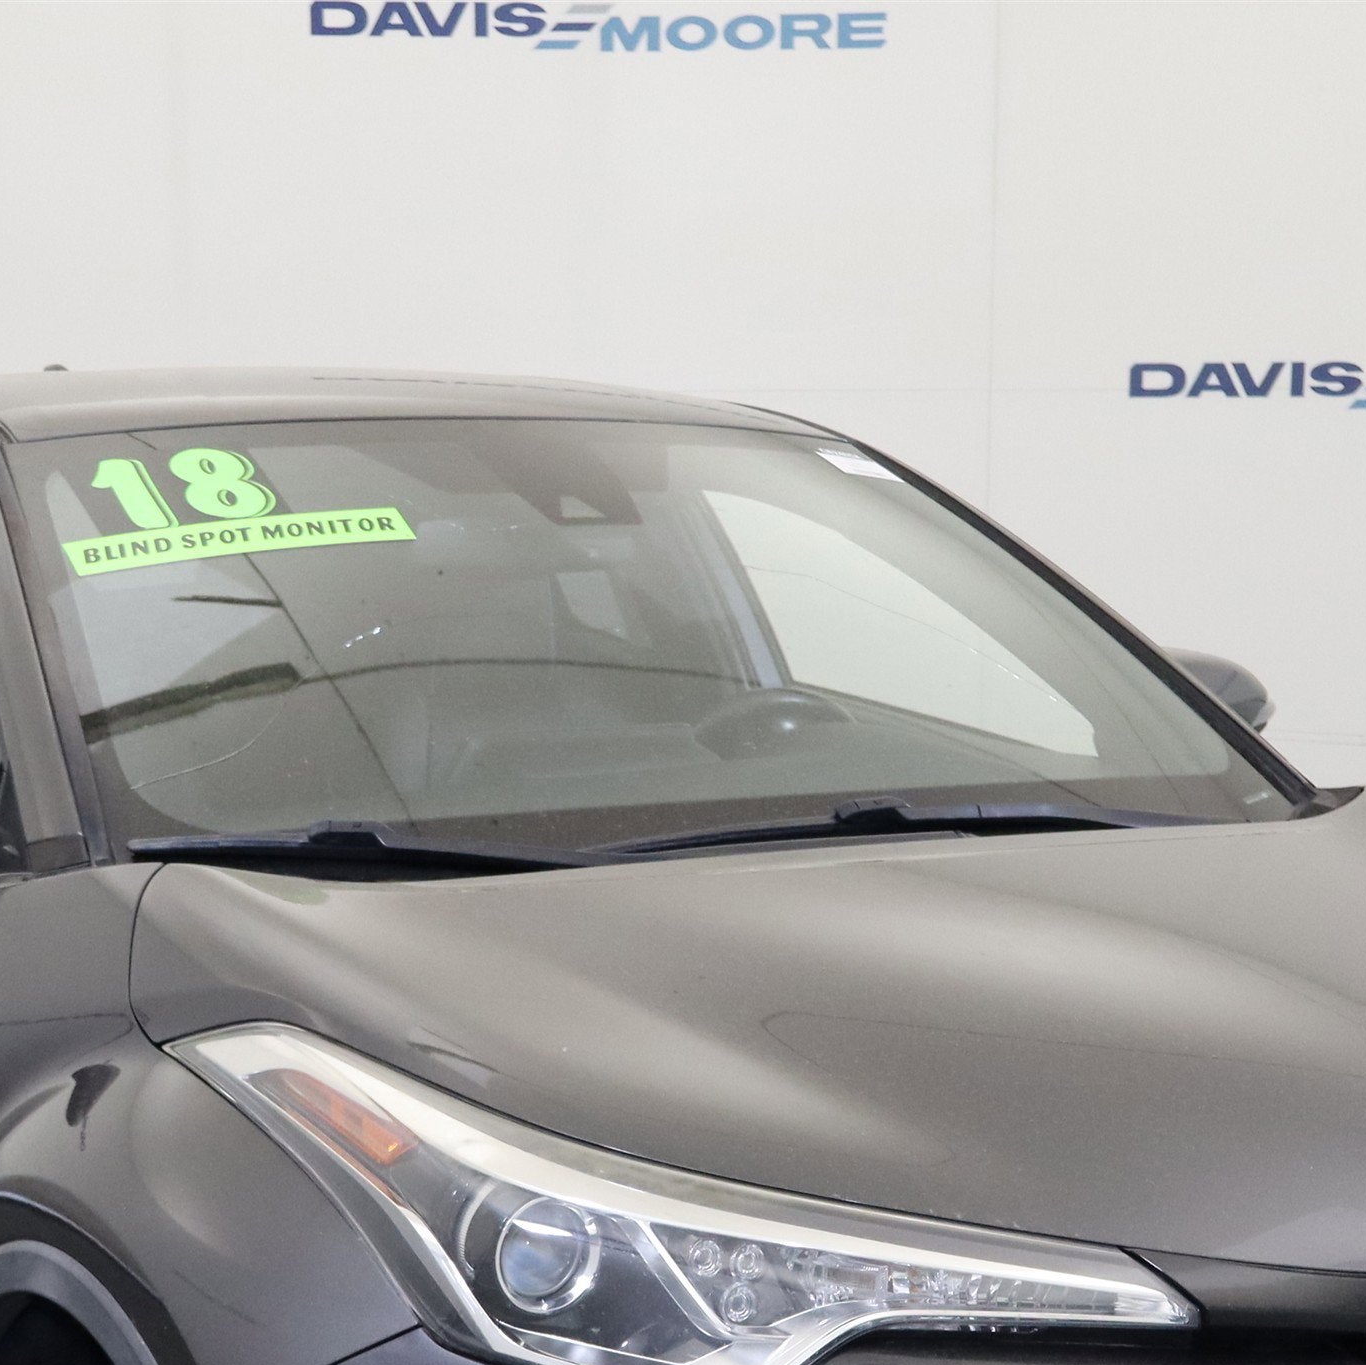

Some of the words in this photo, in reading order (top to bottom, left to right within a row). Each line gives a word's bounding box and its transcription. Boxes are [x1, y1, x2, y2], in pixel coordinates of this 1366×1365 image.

[309, 0, 548, 38] DAVIS
[599, 12, 887, 53] MOORE
[1128, 361, 1364, 399] DAVIS
[90, 448, 277, 530] 18
[83, 537, 173, 564] BLIND
[181, 526, 252, 550] SPOT
[262, 516, 397, 541] MONITOR
